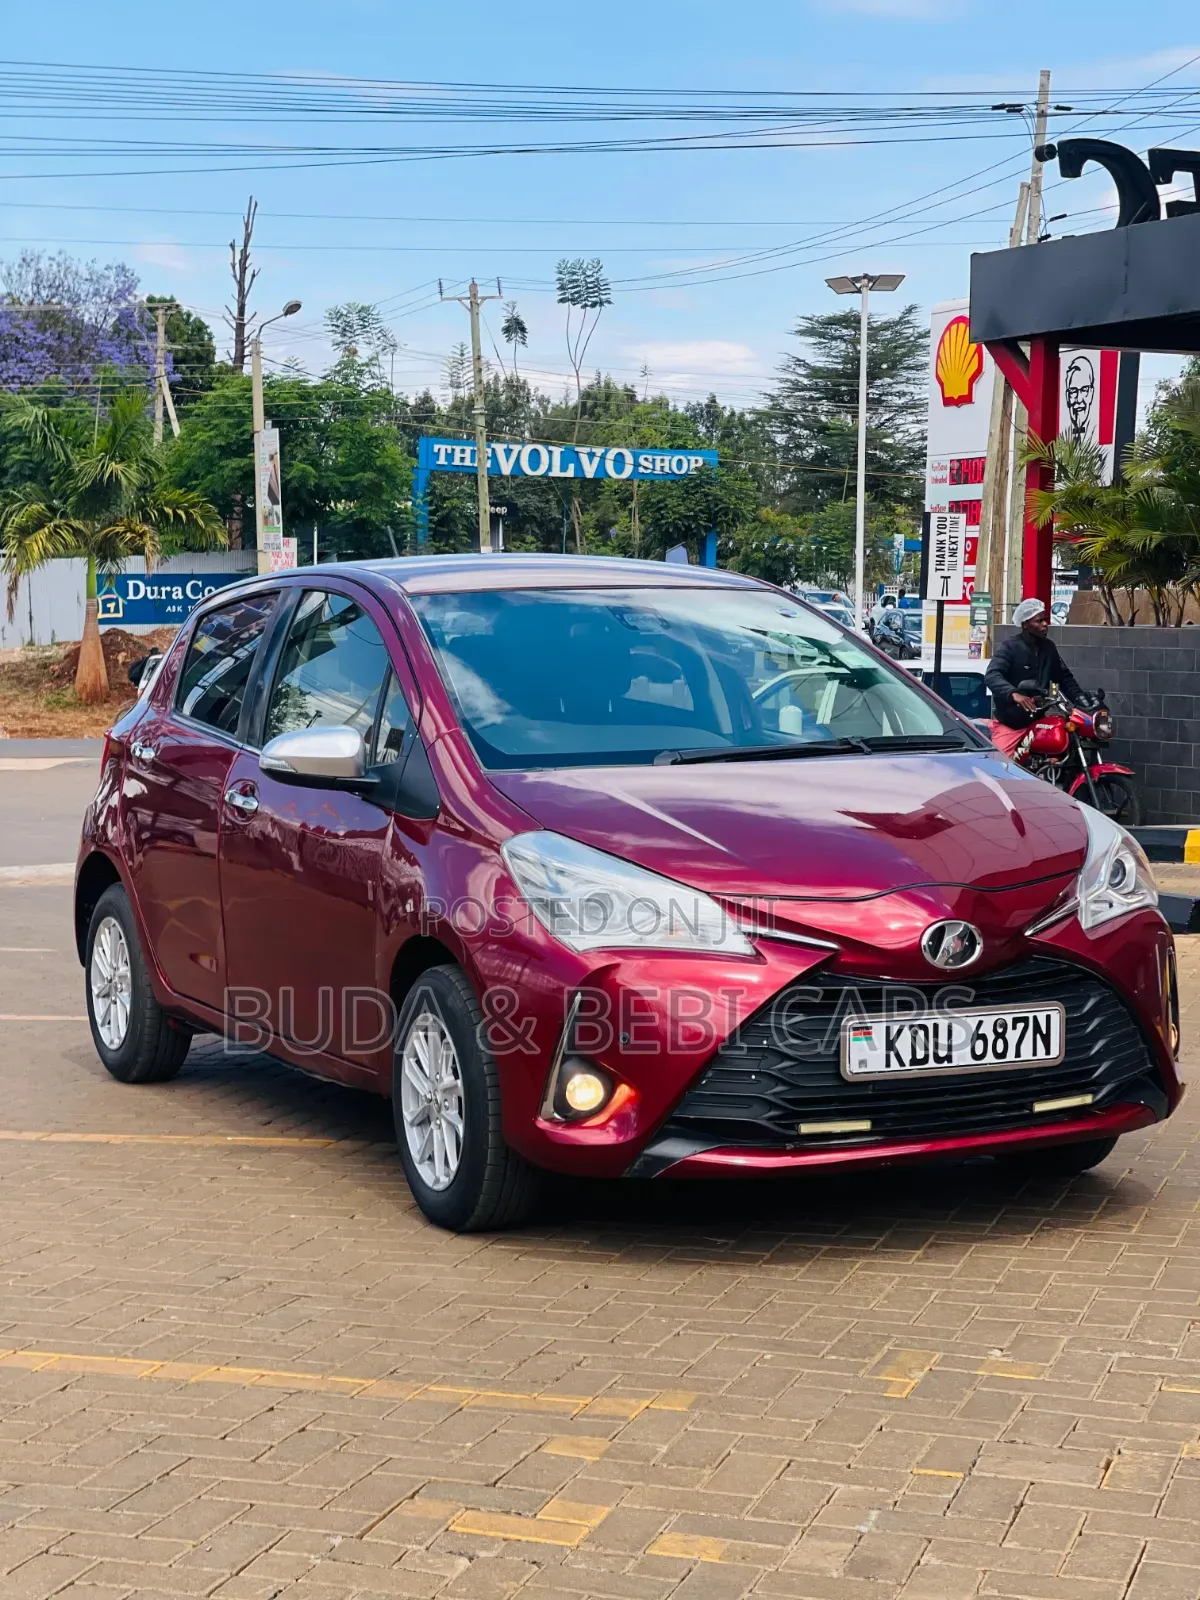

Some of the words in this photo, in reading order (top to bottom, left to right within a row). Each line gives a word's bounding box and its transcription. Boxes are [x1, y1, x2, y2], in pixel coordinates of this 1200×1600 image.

[491, 443, 634, 479] VOLVO
[638, 454, 704, 475] SHOP
[490, 506, 508, 516] eep
[936, 516, 948, 536] YOU
[949, 515, 960, 533] TIME
[935, 539, 947, 573] THANK
[948, 535, 959, 558] NEXT
[947, 560, 958, 571] TILL
[126, 580, 218, 600] DuraCo
[884, 1022, 954, 1069] KDU
[969, 1013, 1052, 1063] 687N
